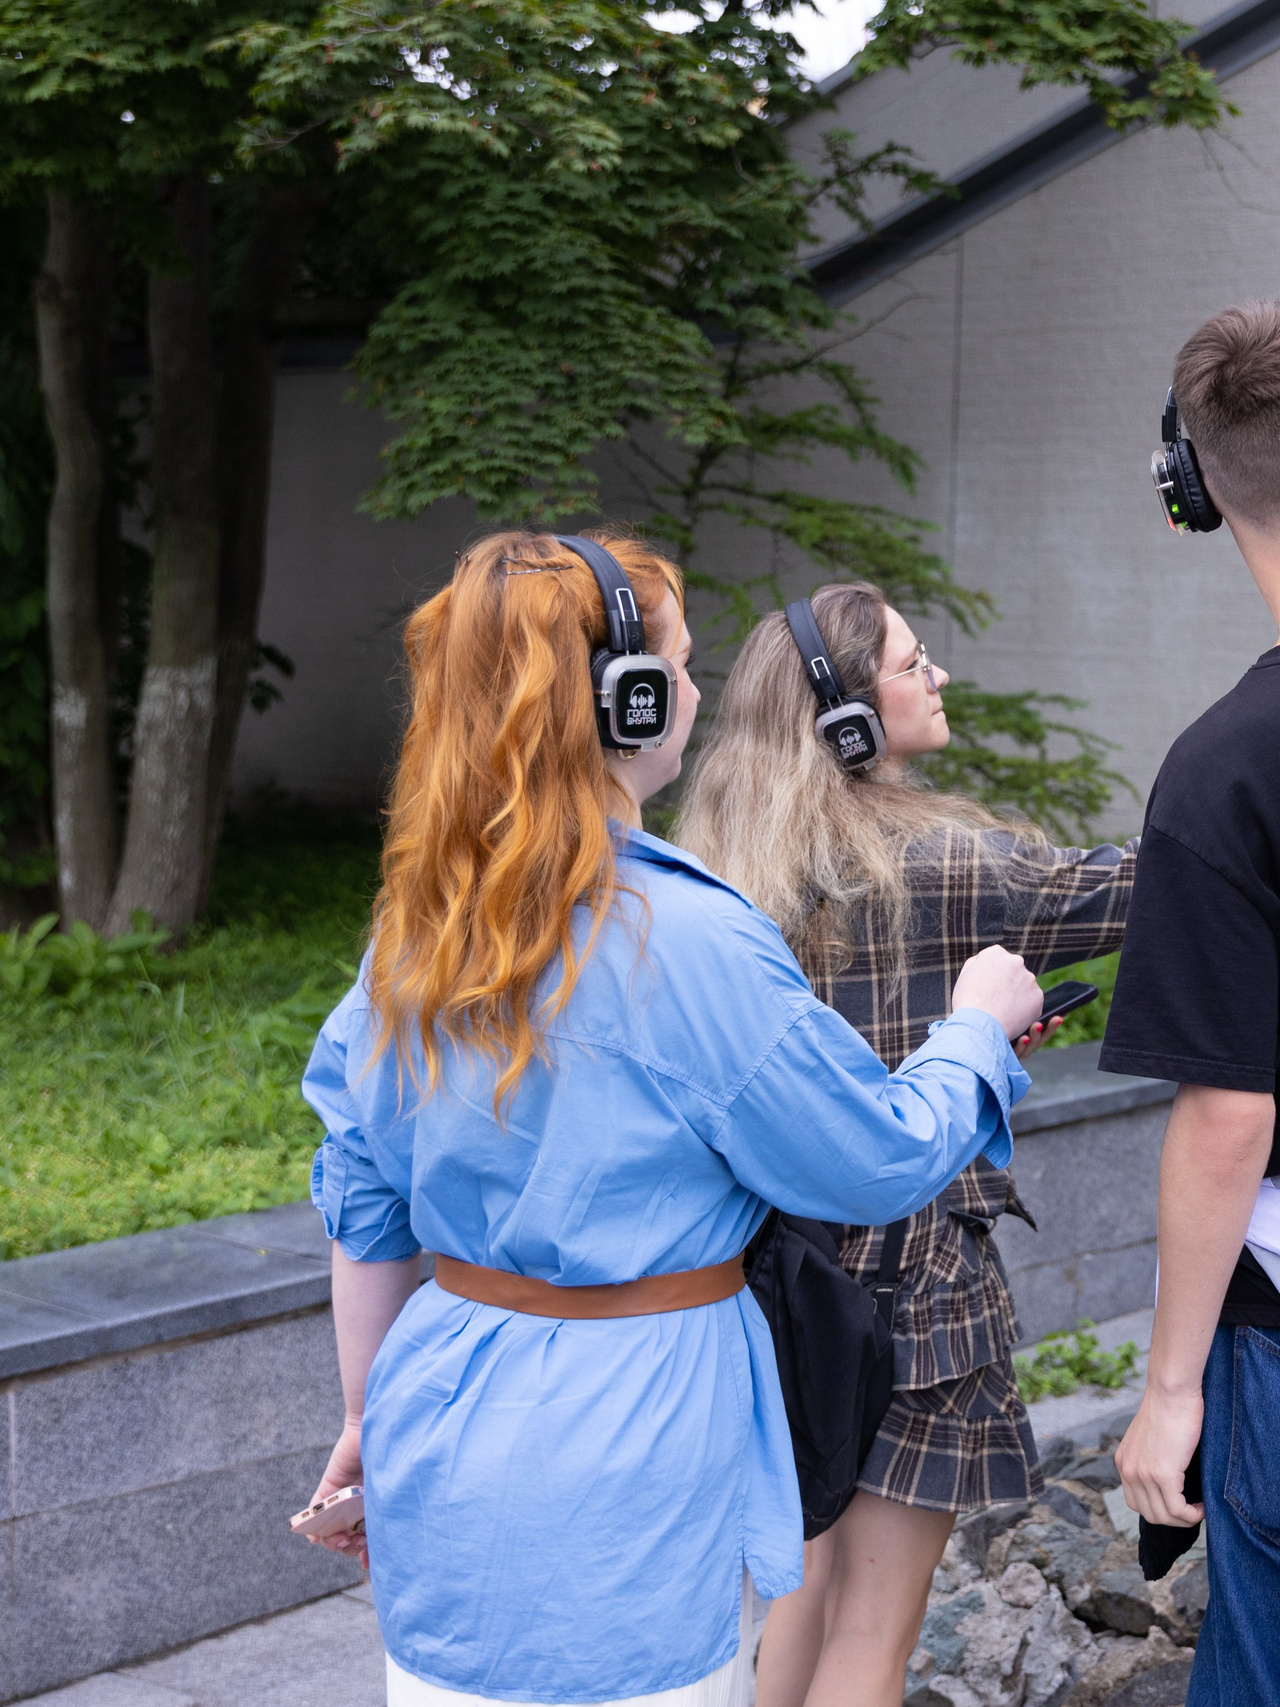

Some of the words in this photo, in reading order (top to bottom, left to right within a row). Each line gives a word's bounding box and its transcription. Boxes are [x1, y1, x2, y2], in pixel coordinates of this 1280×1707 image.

[627, 708, 657, 717] ГОЛОС
[626, 717, 657, 726] ВНУТРИ
[840, 740, 867, 754] ГОЛОС
